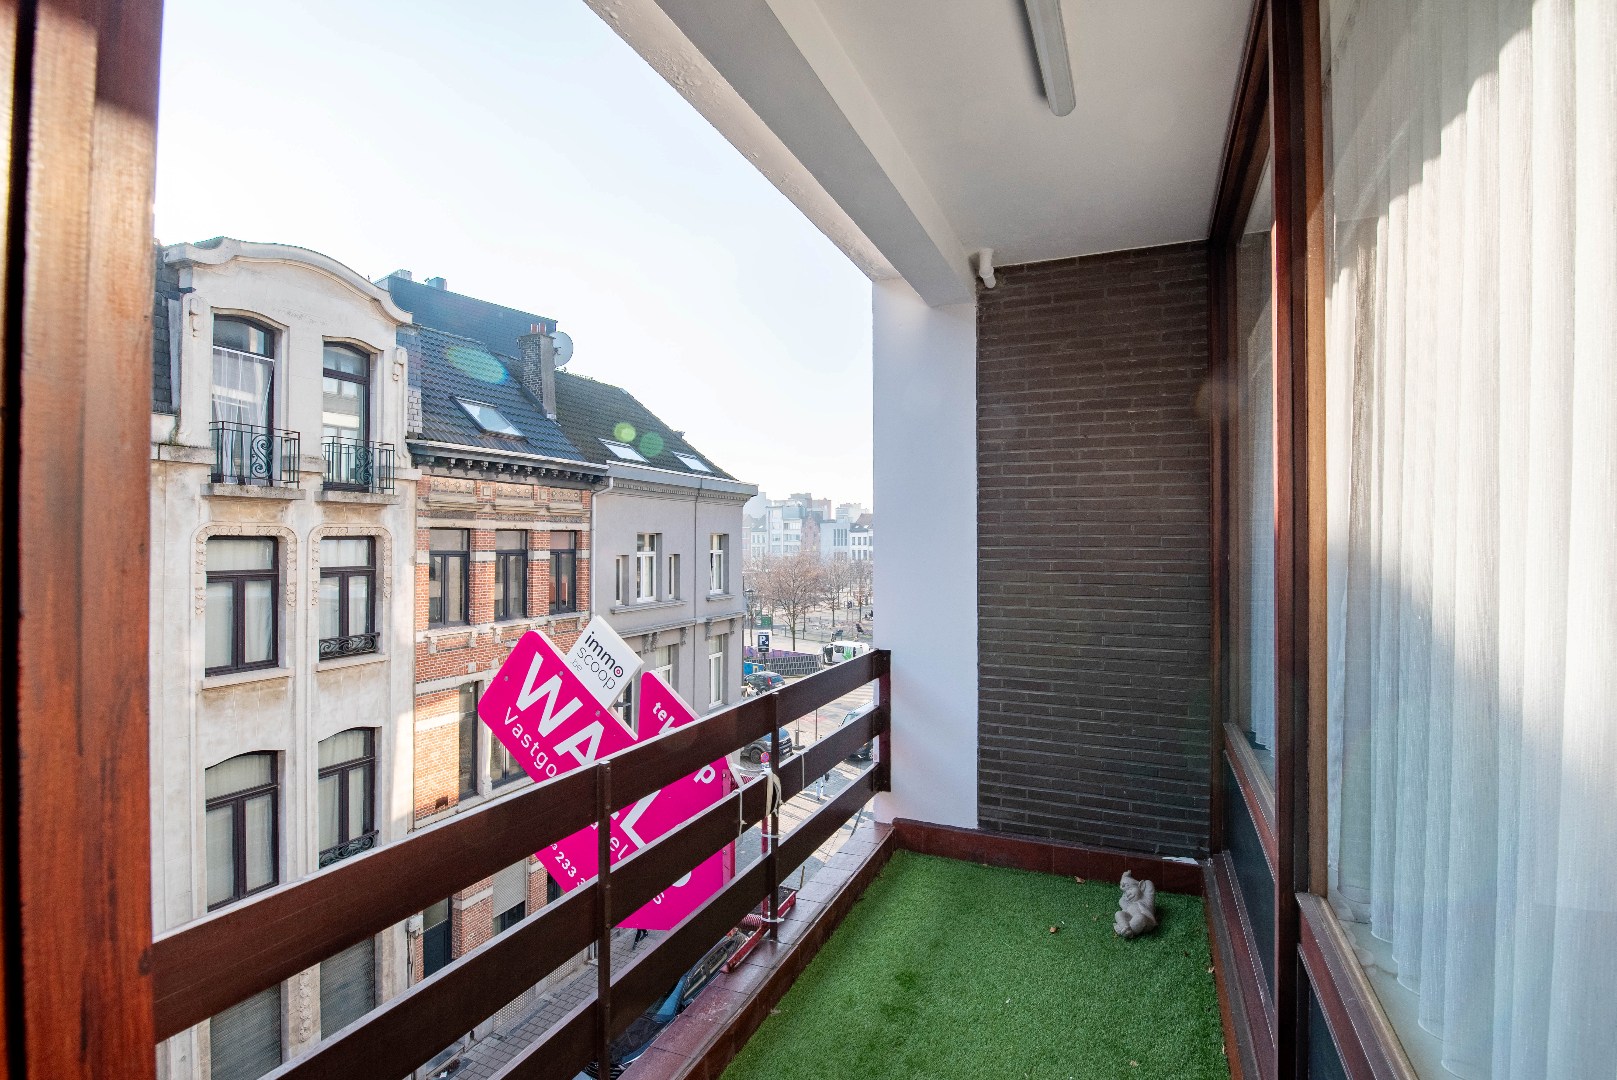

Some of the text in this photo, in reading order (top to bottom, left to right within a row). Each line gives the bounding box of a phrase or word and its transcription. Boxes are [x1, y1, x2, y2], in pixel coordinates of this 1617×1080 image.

[577, 647, 615, 690] scoop
[585, 631, 623, 677] immo
[652, 702, 716, 784] te kp
[554, 851, 577, 878] 233
